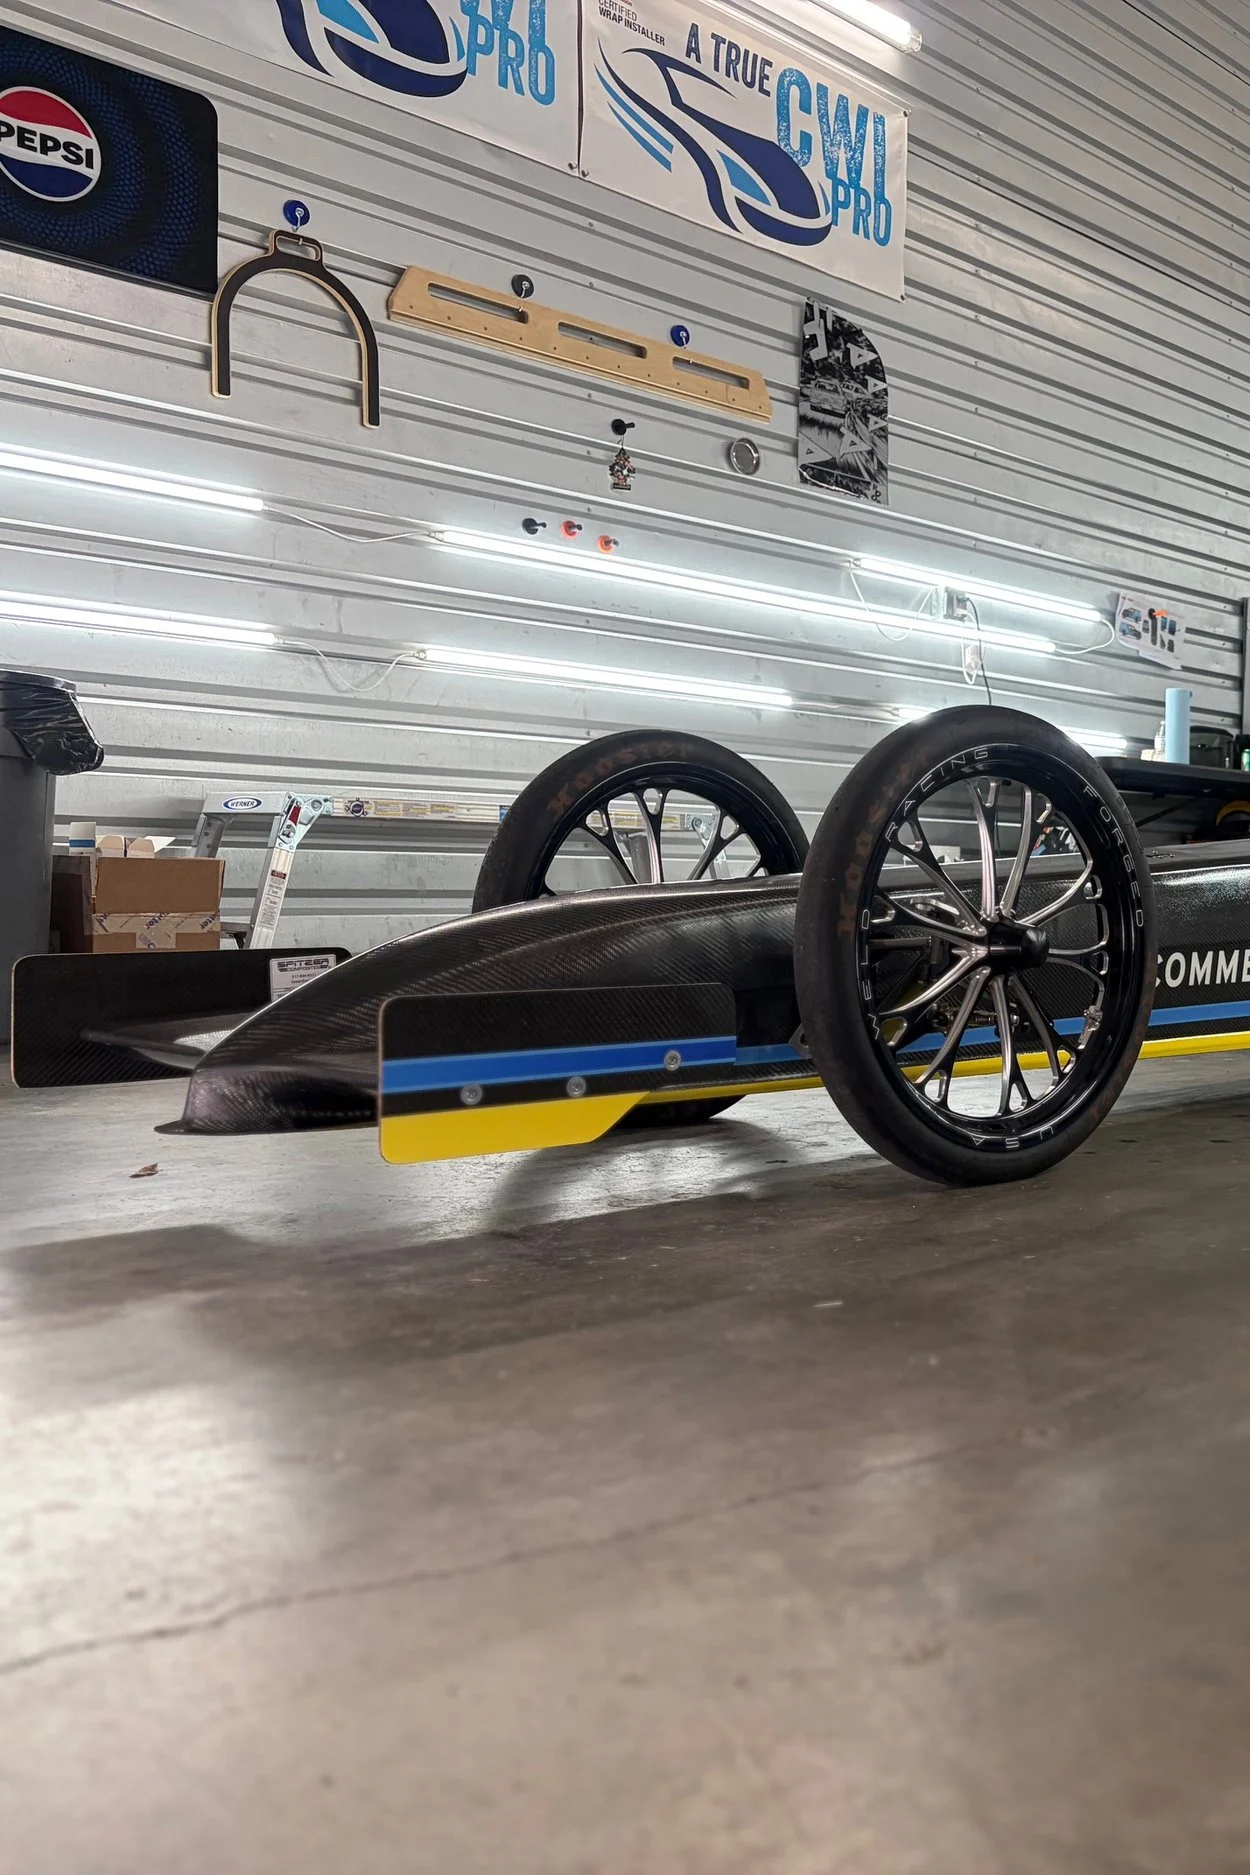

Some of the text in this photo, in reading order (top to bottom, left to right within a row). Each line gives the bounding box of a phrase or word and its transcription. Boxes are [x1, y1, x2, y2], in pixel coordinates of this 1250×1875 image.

[466, 13, 555, 106] PRO
[599, 6, 665, 46] WRAP INSTALLER
[685, 23, 773, 97] A TRUE
[0, 120, 94, 170] PEPSI
[777, 67, 886, 200] CWI
[832, 176, 892, 247] PRO
